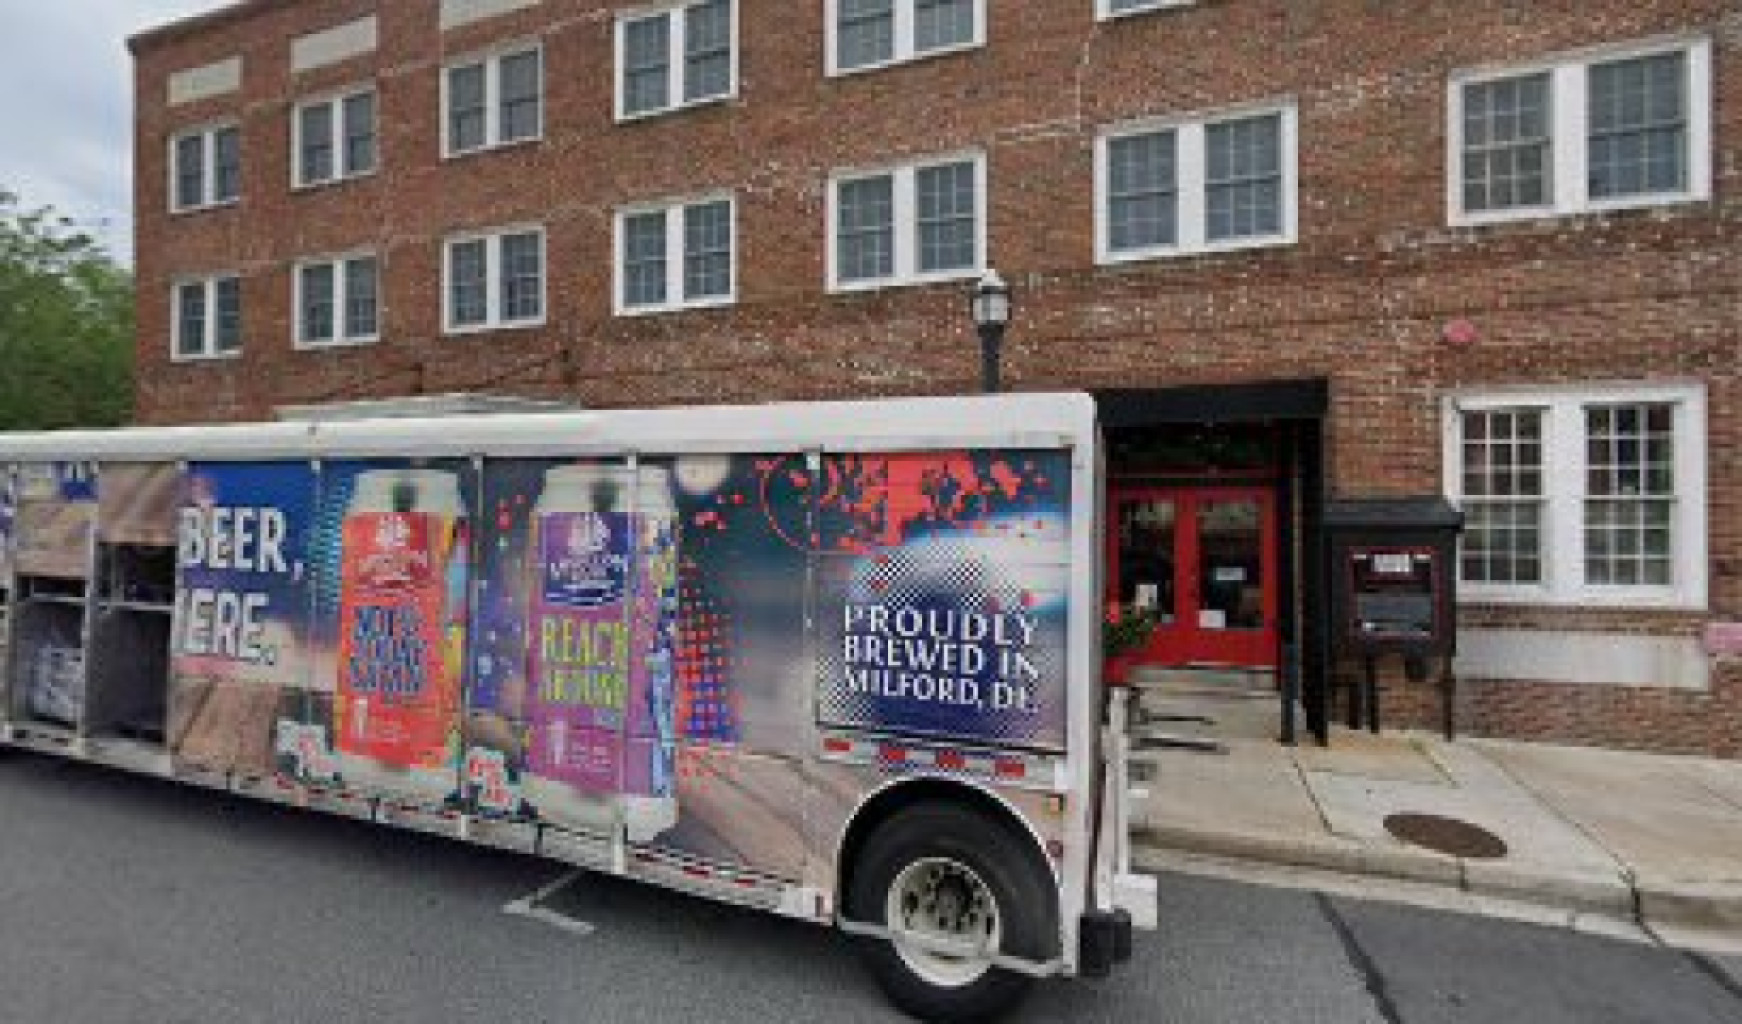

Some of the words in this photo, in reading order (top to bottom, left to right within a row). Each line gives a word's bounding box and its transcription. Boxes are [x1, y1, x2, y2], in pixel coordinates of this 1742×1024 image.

[178, 506, 303, 581] BEER,
[844, 604, 1038, 646] PROUDLY
[844, 635, 984, 675] BREWED
[1001, 648, 1039, 679] IN
[844, 664, 984, 712] MILFORD,
